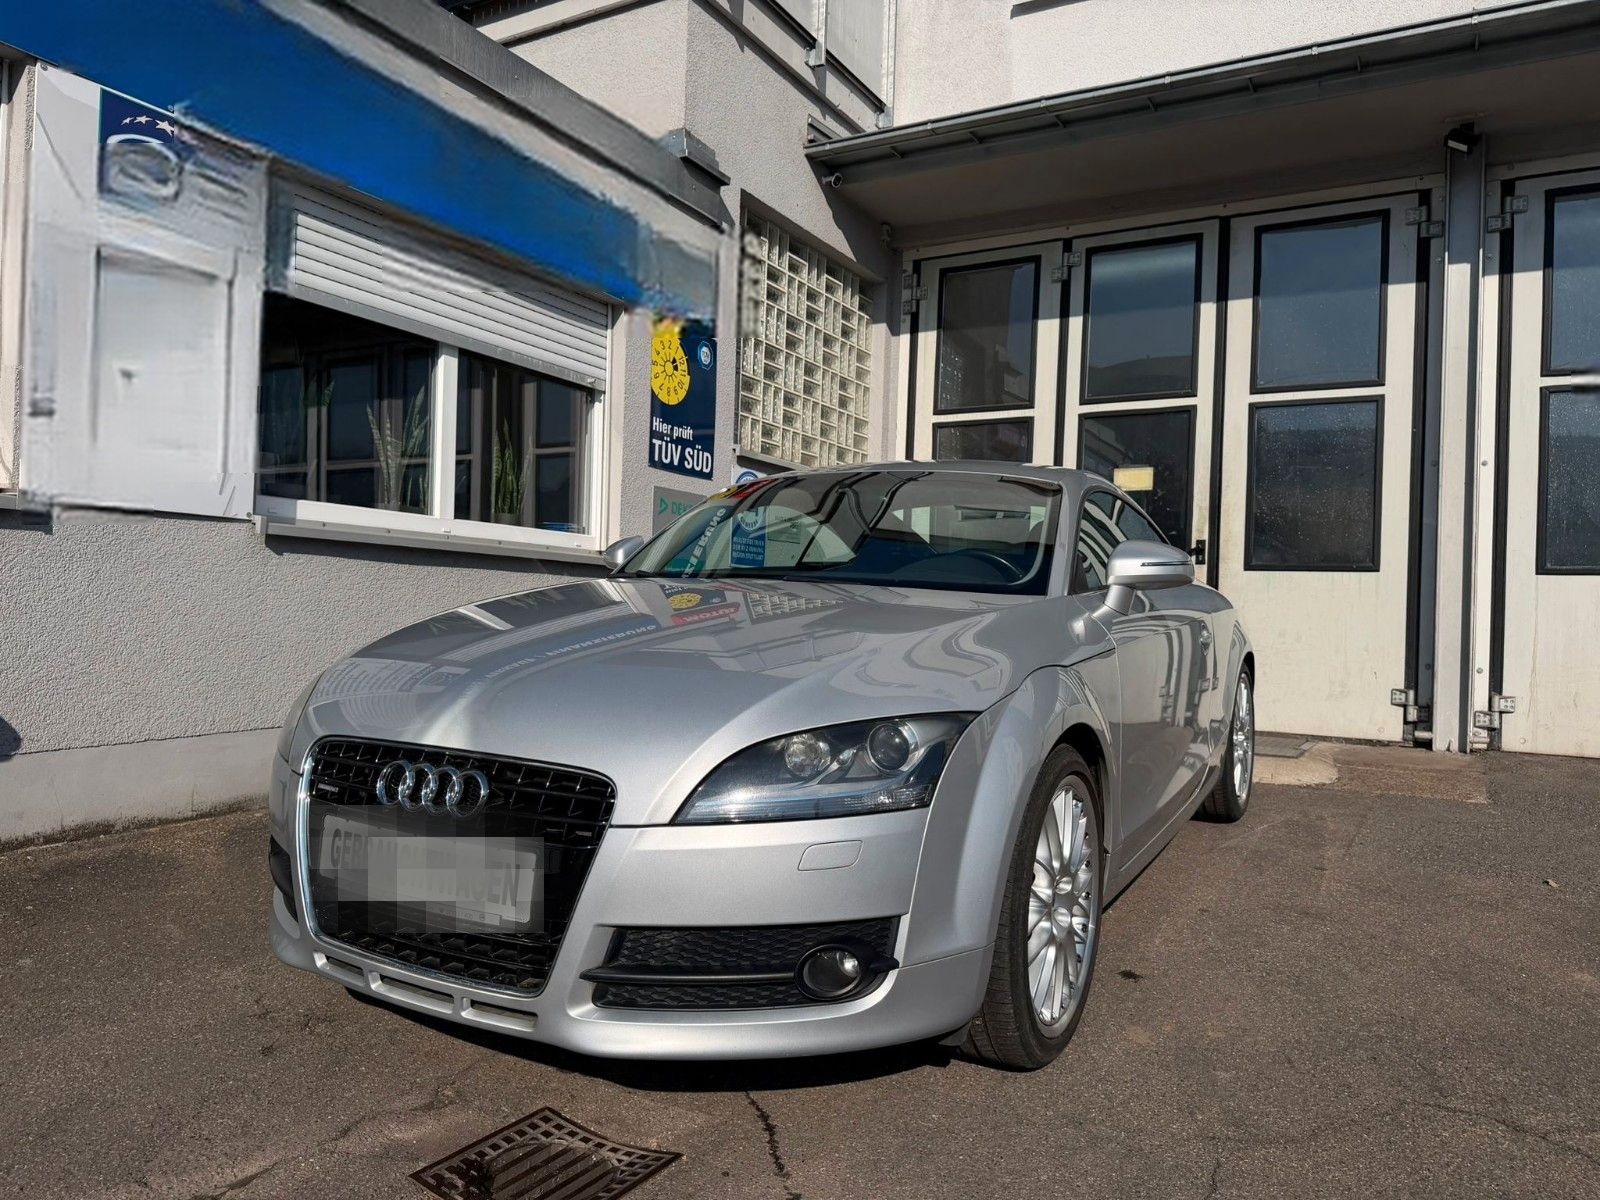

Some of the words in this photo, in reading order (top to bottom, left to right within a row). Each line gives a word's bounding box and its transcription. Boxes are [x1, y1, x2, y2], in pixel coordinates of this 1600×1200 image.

[652, 416, 672, 435] Hier
[673, 425, 693, 441] prüft
[652, 436, 682, 466] TÜV
[684, 444, 712, 473] SÜD
